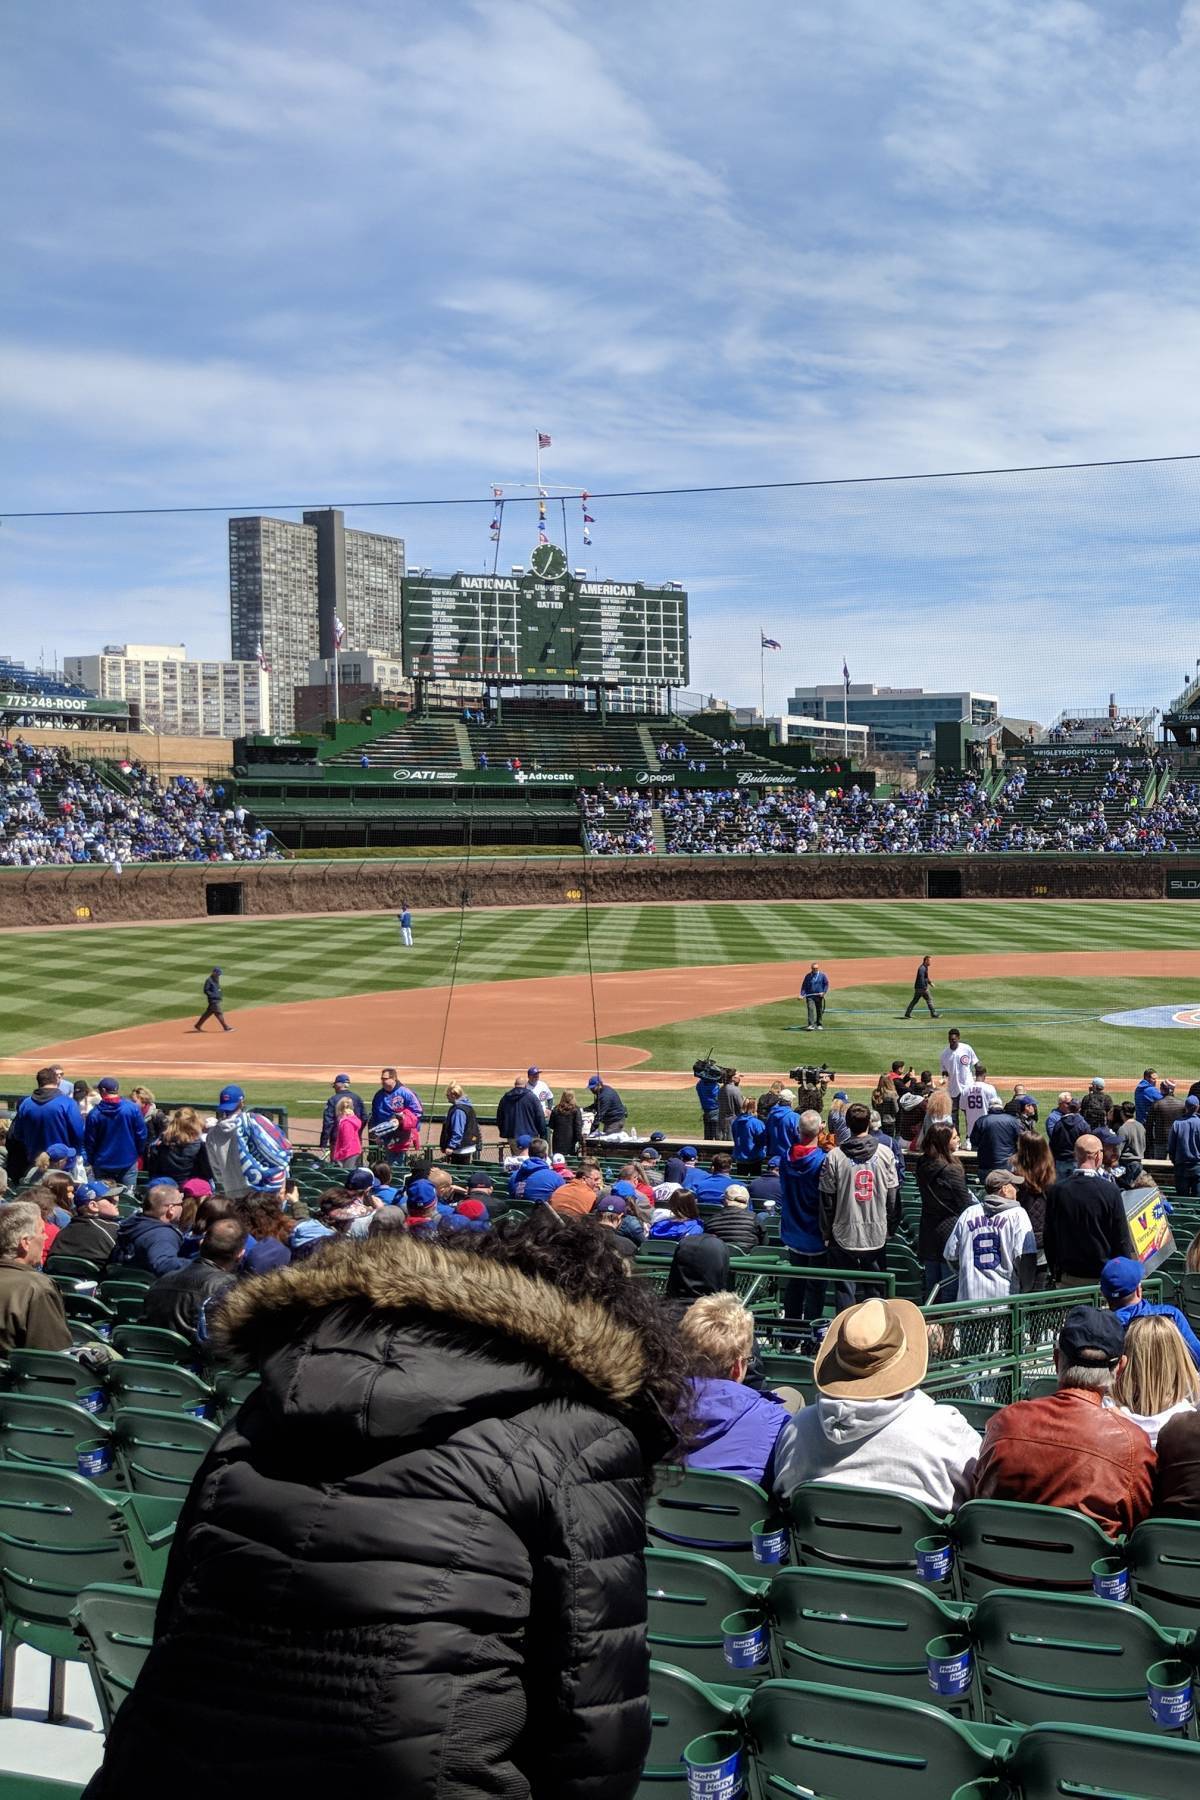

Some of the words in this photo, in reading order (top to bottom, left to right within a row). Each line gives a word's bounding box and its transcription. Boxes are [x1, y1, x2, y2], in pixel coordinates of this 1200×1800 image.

[461, 577, 520, 590] NATIONAL
[580, 583, 636, 596] AMERICAN
[6, 695, 88, 711] 773-248-ROOF
[410, 770, 436, 779] ATI
[528, 772, 575, 781] Advocate
[650, 773, 675, 783] pepsi
[736, 772, 798, 784] Budweiser
[567, 890, 581, 899] 400
[968, 1095, 983, 1109] 69
[853, 1169, 875, 1201] 9
[967, 1215, 1008, 1232] DAWSON
[973, 1233, 1001, 1269] 8
[926, 1553, 943, 1562] Hefty
[1101, 1579, 1119, 1588] Hefty
[733, 1638, 755, 1648] Hefty
[939, 1662, 961, 1673] Hefty
[1161, 1695, 1184, 1705] Hefty
[693, 1769, 720, 1781] Hefty
[705, 1775, 734, 1792] Hefty
